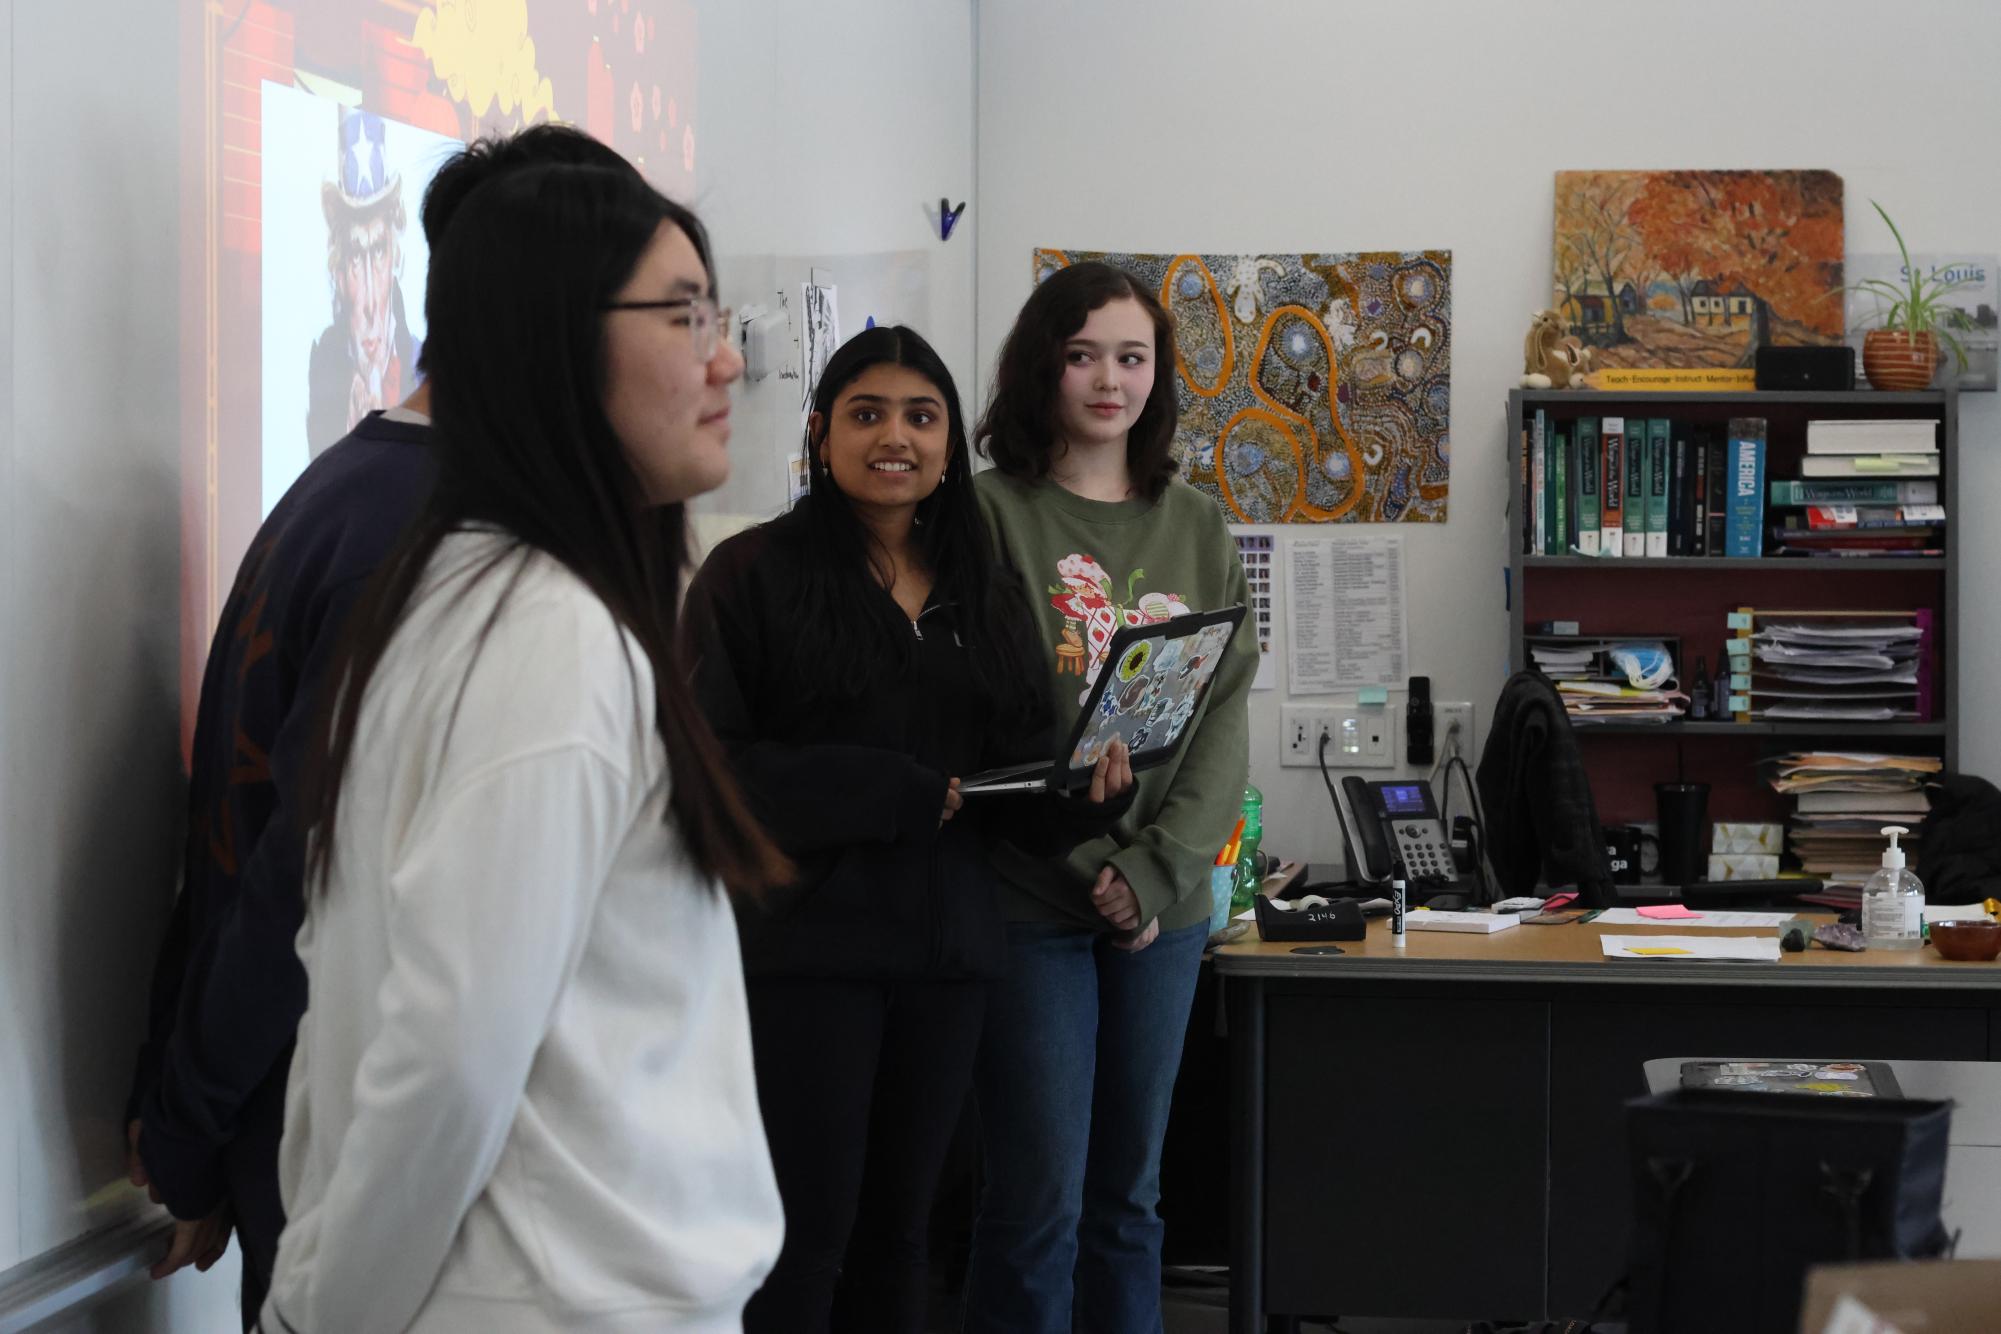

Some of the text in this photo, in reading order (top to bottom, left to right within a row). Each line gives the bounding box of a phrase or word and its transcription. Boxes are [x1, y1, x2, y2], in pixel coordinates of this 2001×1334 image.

[1931, 264, 1985, 282] Louis
[1606, 375, 1628, 383] Teach
[1632, 375, 1671, 384] Encourage
[1675, 375, 1702, 383] Instruct
[1706, 375, 1732, 384] Mentor
[1738, 441, 1755, 496] AMERICA
[1393, 890, 1402, 915] EXPO
